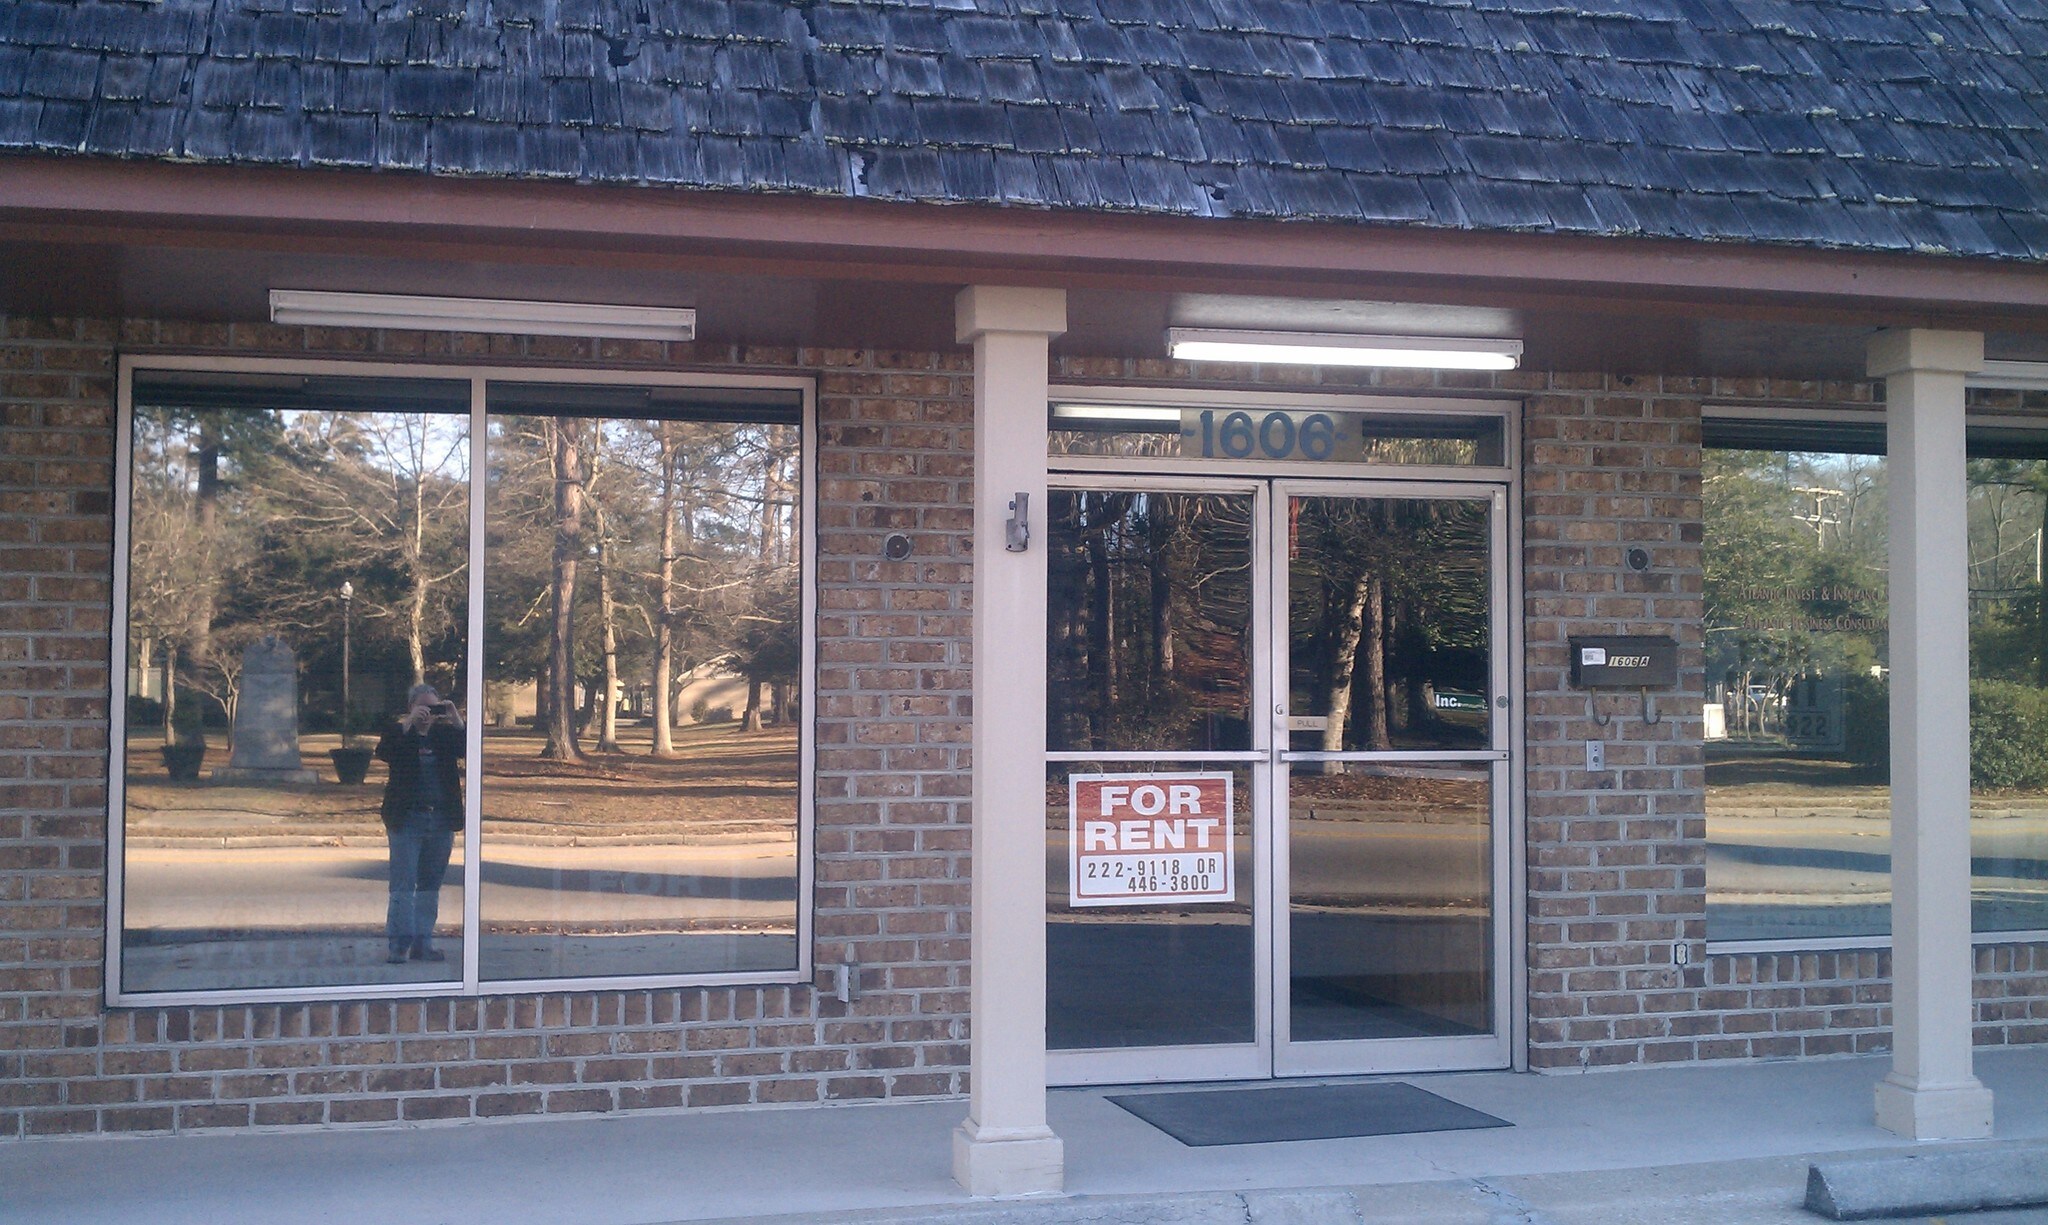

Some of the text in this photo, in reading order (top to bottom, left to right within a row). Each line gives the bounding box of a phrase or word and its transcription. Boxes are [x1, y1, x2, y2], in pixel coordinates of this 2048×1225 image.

[1435, 694, 1461, 707] Inc.
[1297, 719, 1318, 728] PULL
[1101, 785, 1202, 816] FOR
[1084, 818, 1219, 851] RENT
[1088, 858, 1216, 878] 222-9118 OR
[1128, 874, 1209, 892] 446-3800
